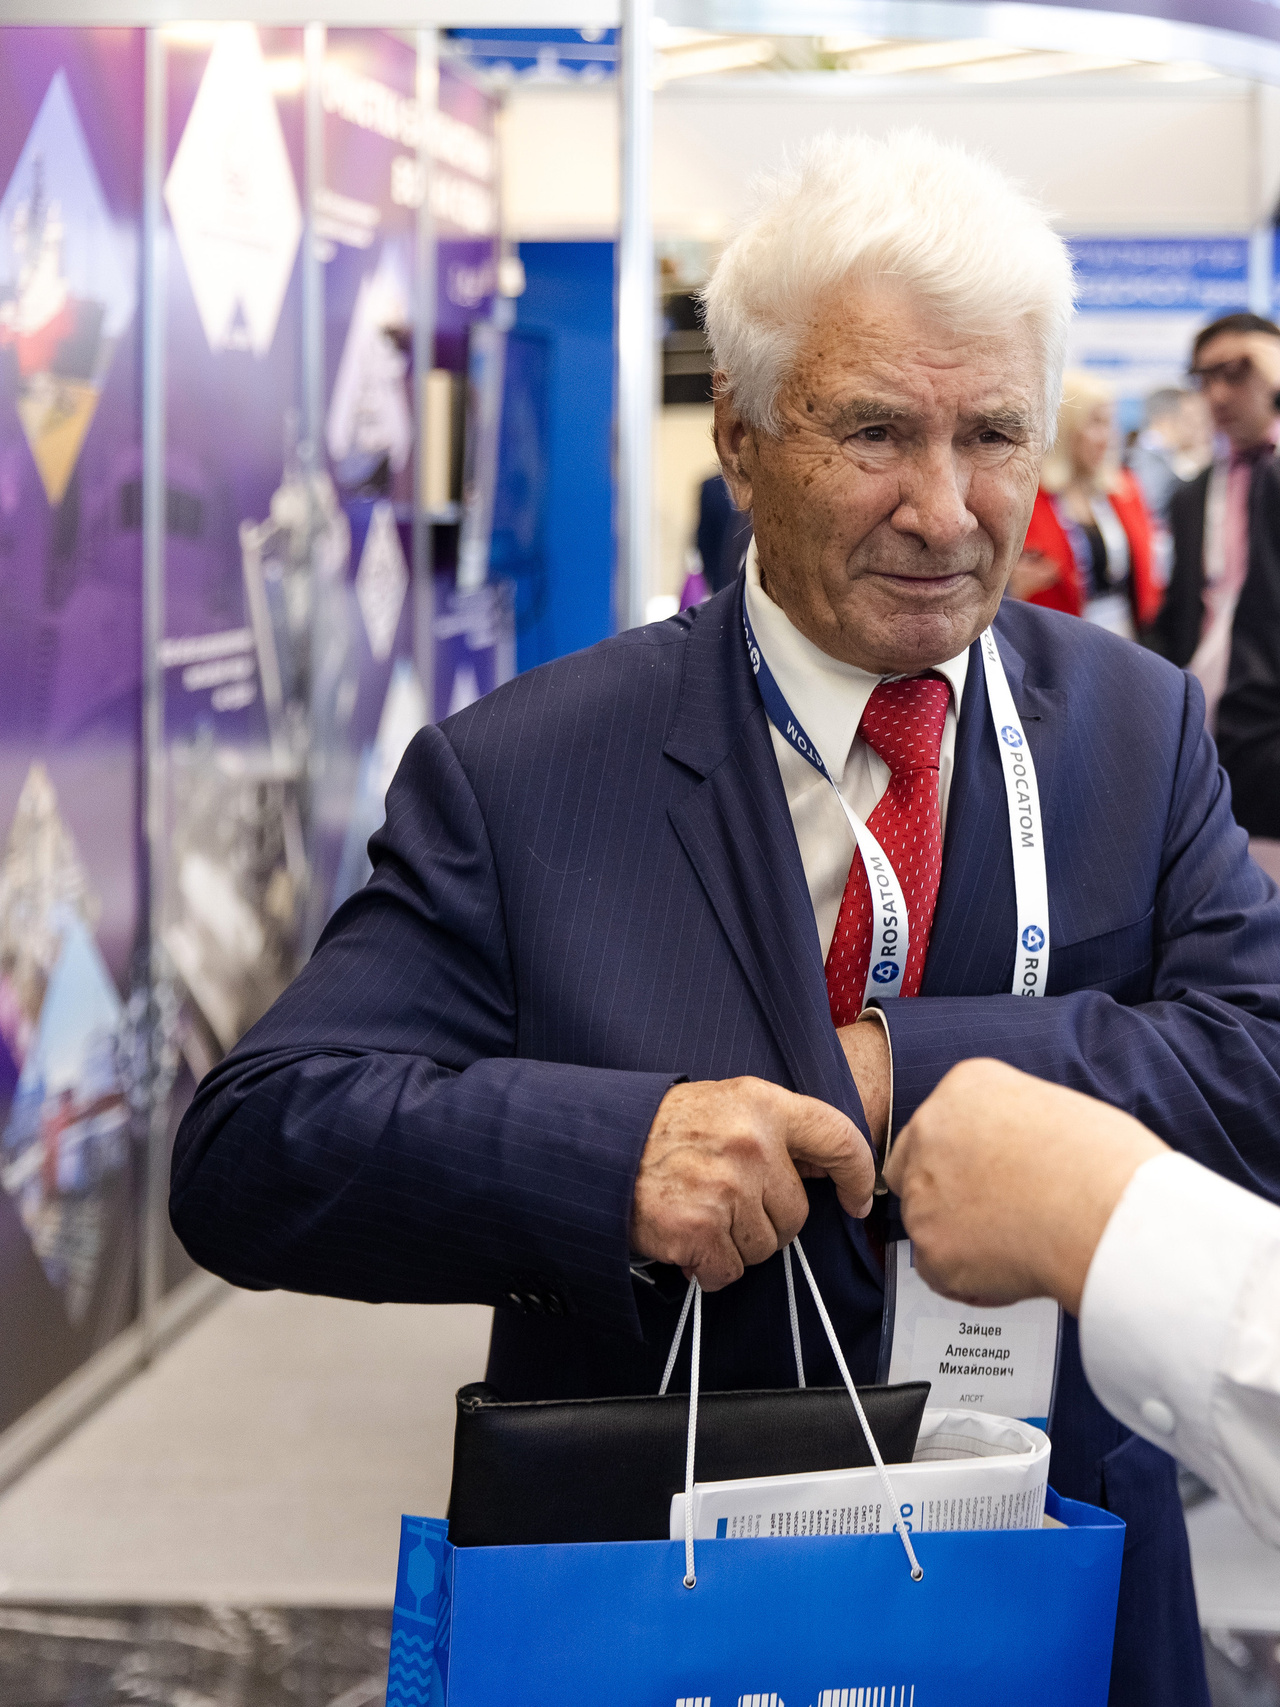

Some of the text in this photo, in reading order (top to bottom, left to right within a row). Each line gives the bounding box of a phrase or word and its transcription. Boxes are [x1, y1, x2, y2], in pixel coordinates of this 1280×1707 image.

[1010, 752, 1034, 847] РОСАТОМ
[870, 857, 898, 957] ROSATOM
[958, 1322, 1002, 1337] Зайцев
[945, 1344, 1011, 1360] Александр
[939, 1362, 1014, 1377] Михайлович
